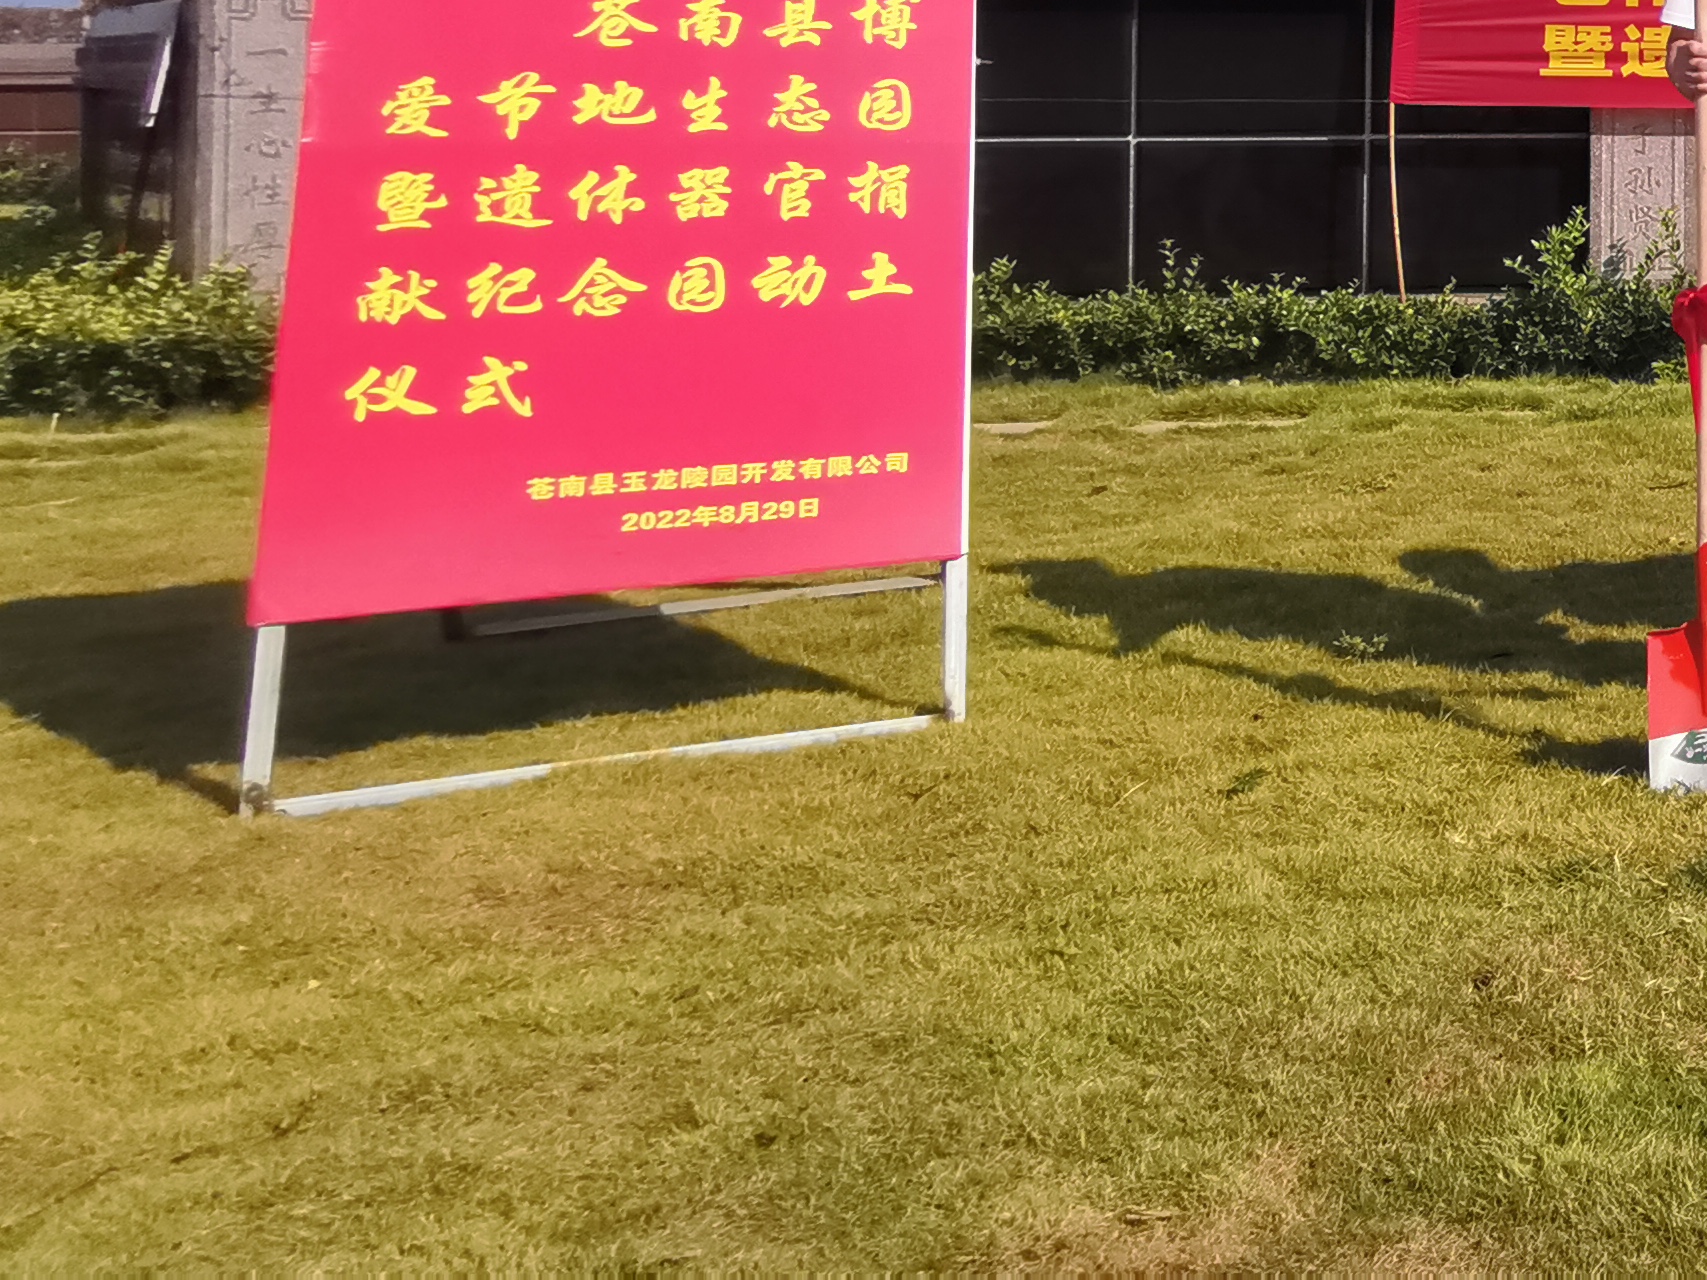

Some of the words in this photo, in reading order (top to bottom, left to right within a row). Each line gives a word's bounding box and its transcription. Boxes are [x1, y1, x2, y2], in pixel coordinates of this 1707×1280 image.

[381, 72, 912, 140] 爱节地生态园
[377, 162, 910, 232] 暨遗体器官捐
[357, 252, 913, 325] 献纪念园动土
[344, 356, 533, 422] 仪式
[528, 452, 909, 501] 苍南县玉龙陵园开发有限公司
[622, 498, 819, 532] 2022年8月29日
